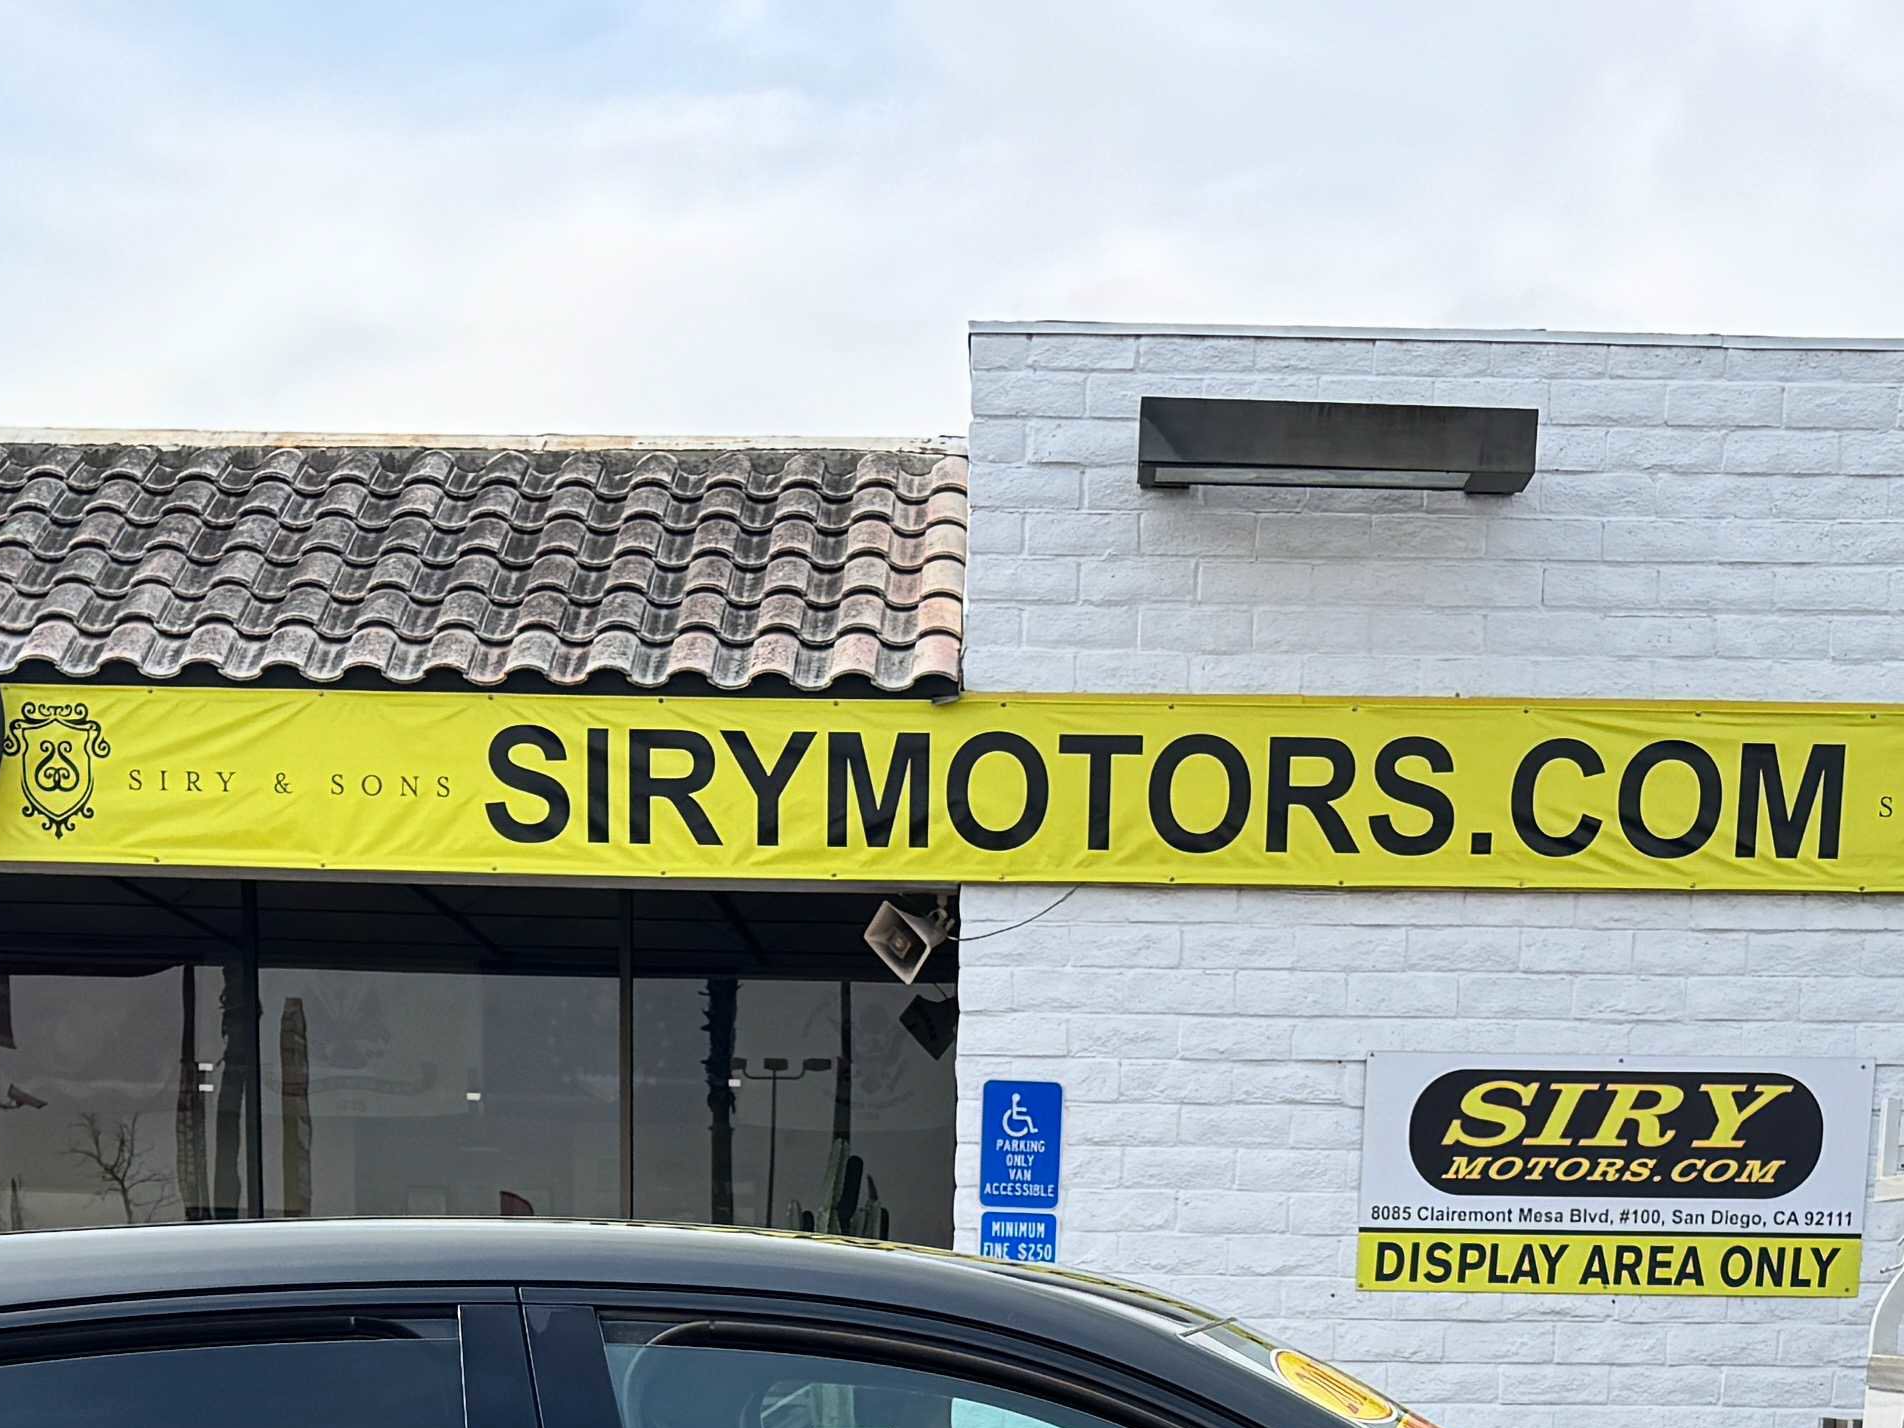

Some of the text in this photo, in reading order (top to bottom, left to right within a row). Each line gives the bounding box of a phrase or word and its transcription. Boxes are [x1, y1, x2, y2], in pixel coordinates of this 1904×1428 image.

[129, 769, 451, 798] SIRY & SONS
[484, 722, 1848, 862] SIRYMOTORS.COM
[1440, 1080, 1794, 1149] SIRY
[996, 1139, 1046, 1152] PARKING
[1006, 1154, 1034, 1167] ONLY
[1440, 1155, 1786, 1184] MOTORS.COM
[1009, 1169, 1031, 1181] VAN
[984, 1183, 1055, 1197] ACCESSIBLE
[1371, 1205, 1853, 1229] 8085 Clairemont Mesa Blvd, #100, San Diego, CA 92111
[992, 1221, 1045, 1238] MINIMUM
[983, 1242, 1053, 1261] FINE $250
[1375, 1241, 1842, 1289] DISPLAY AREA ONLY
